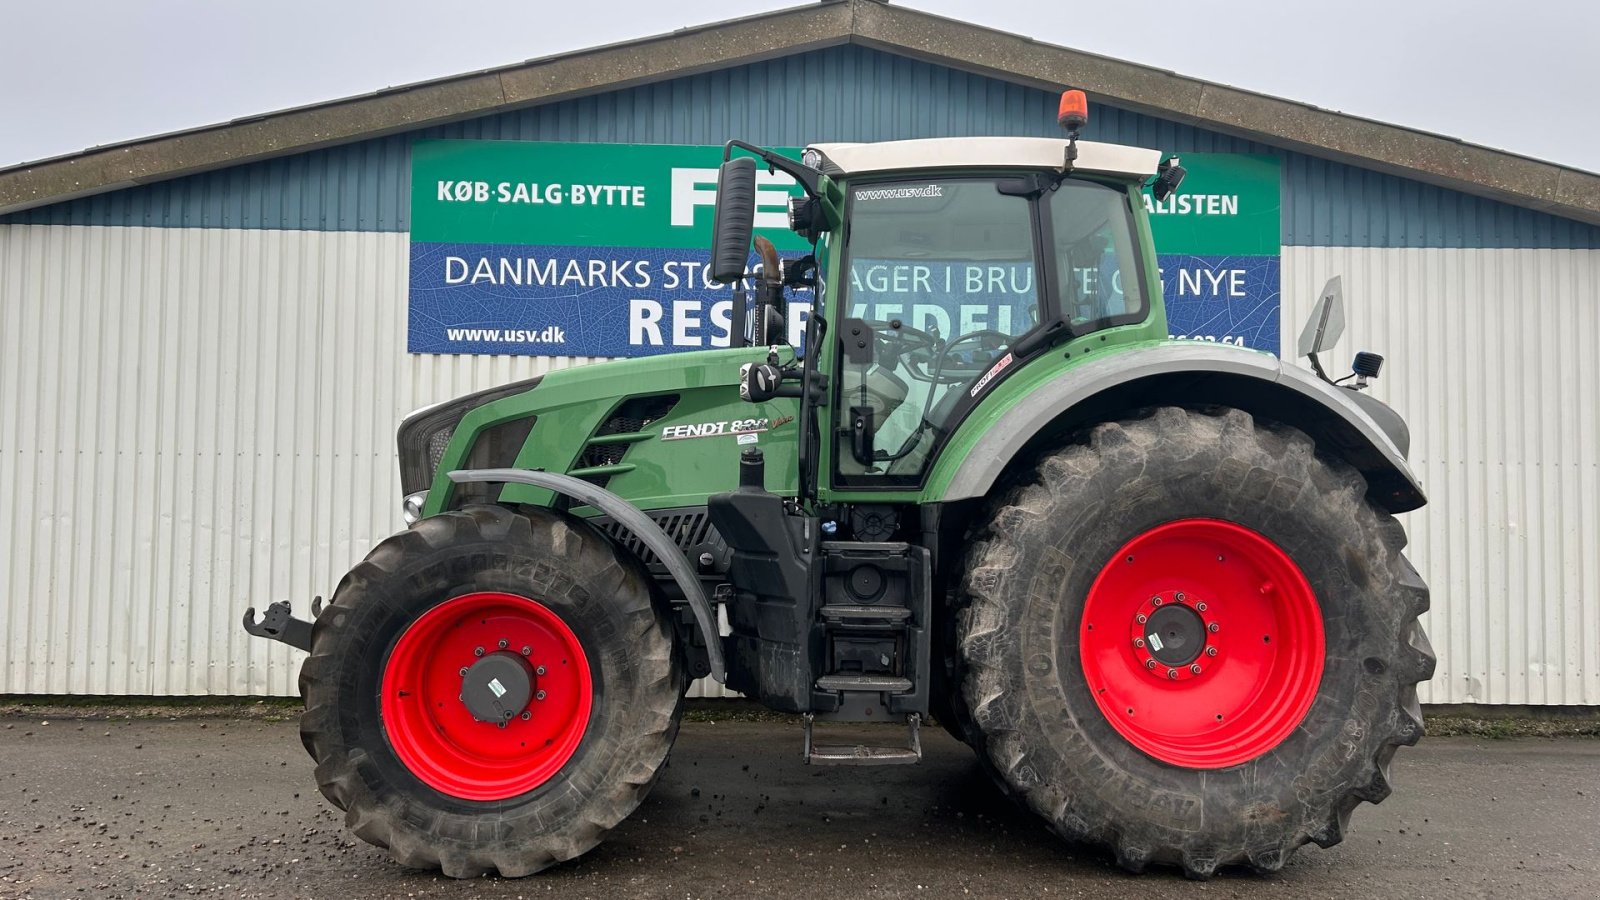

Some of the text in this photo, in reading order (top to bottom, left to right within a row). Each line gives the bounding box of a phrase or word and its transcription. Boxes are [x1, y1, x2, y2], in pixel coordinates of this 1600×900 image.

[855, 184, 942, 201] www.usv.dk
[1143, 193, 1238, 215] ALISTEN
[445, 256, 650, 288] DANMARKS
[1179, 268, 1247, 297] NYE
[447, 326, 565, 344] www.usv.dk
[662, 421, 729, 438] FENDT
